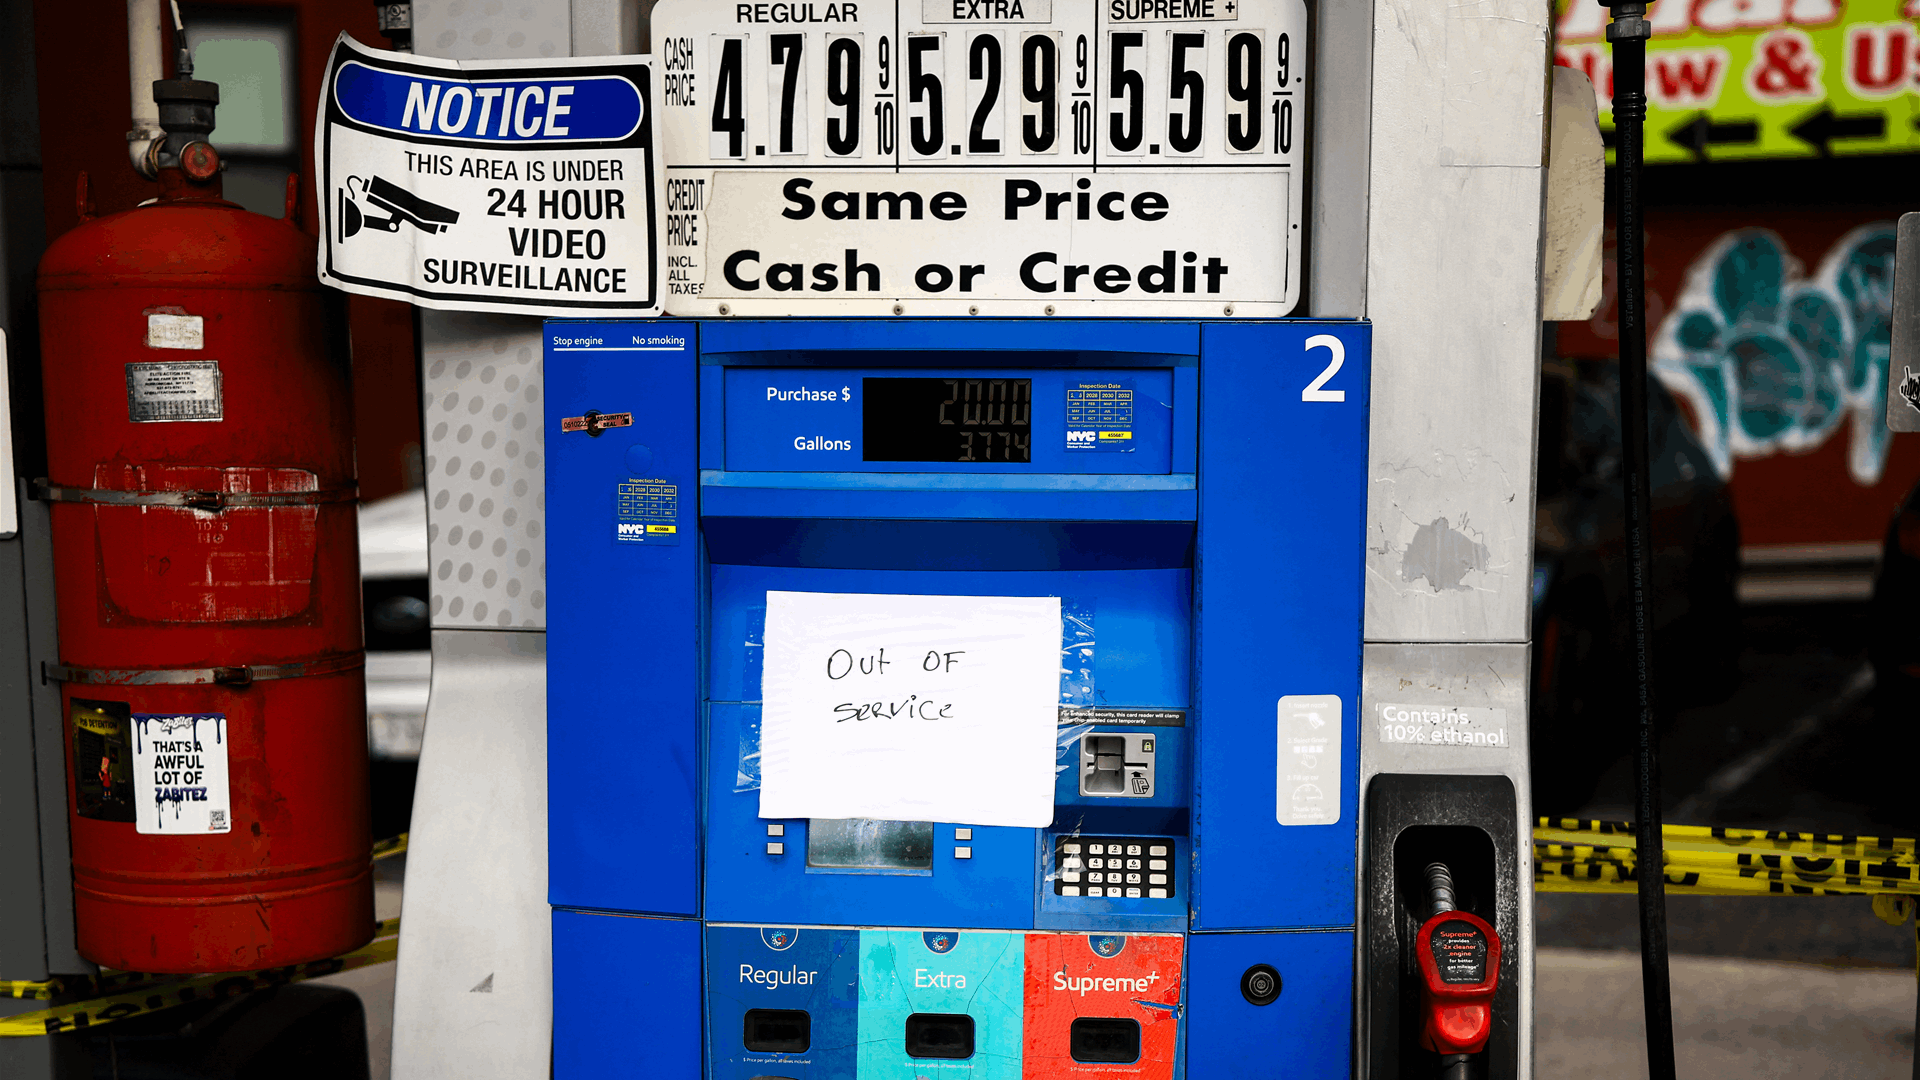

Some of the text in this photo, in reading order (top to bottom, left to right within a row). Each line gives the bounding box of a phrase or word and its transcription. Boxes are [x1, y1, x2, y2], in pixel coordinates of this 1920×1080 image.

[737, 3, 857, 23] REGULAR
[953, 0, 1024, 19] EXTRA
[1111, 0, 1215, 19] SUPREME
[665, 37, 693, 70] CASH
[665, 73, 695, 106] PRICE
[712, 33, 860, 158] 4.79
[908, 35, 1055, 155] 5.29
[1108, 32, 1261, 155] 5.59
[401, 81, 575, 138] NOTICE
[405, 151, 623, 181] THIS AREA IS UNDER
[487, 188, 625, 220] 24 HOUR
[667, 178, 704, 211] CREDIT
[782, 178, 1169, 221] Same Price
[1623, 177, 1632, 224] SYSTEMS
[667, 214, 697, 246] PRICE
[1623, 225, 1632, 261] VAPOR
[509, 227, 605, 262] VIDEO
[668, 256, 698, 268] INCL.
[723, 249, 1228, 293] Cash or Credit
[1624, 263, 1632, 276] BY
[423, 258, 626, 293] SURVEILLANCE
[669, 270, 689, 281] ALL
[552, 335, 603, 347] Stop engine
[632, 335, 685, 347] No smoking
[1302, 335, 1345, 402] 2
[768, 386, 850, 402] Purchase $
[939, 379, 1030, 425] 20.00
[795, 436, 851, 450] Gallons
[958, 431, 1029, 461] 3.774
[1067, 431, 1096, 442] NYC
[618, 523, 644, 535] NYC
[1632, 527, 1640, 547] USA
[1632, 549, 1641, 559] IN
[1633, 561, 1642, 588] MADE
[1635, 605, 1644, 631] HOSE
[828, 648, 890, 679] Out
[1636, 633, 1646, 681] GASOLINE
[1382, 706, 1469, 725] Contains
[194, 740, 203, 753] A
[1384, 724, 1505, 744] 10% ethanol
[154, 755, 204, 769] AWFUL
[155, 771, 202, 785] LOT OF
[154, 786, 207, 801] ZABITEZ
[739, 964, 817, 990] Regular
[915, 969, 966, 988] Extra
